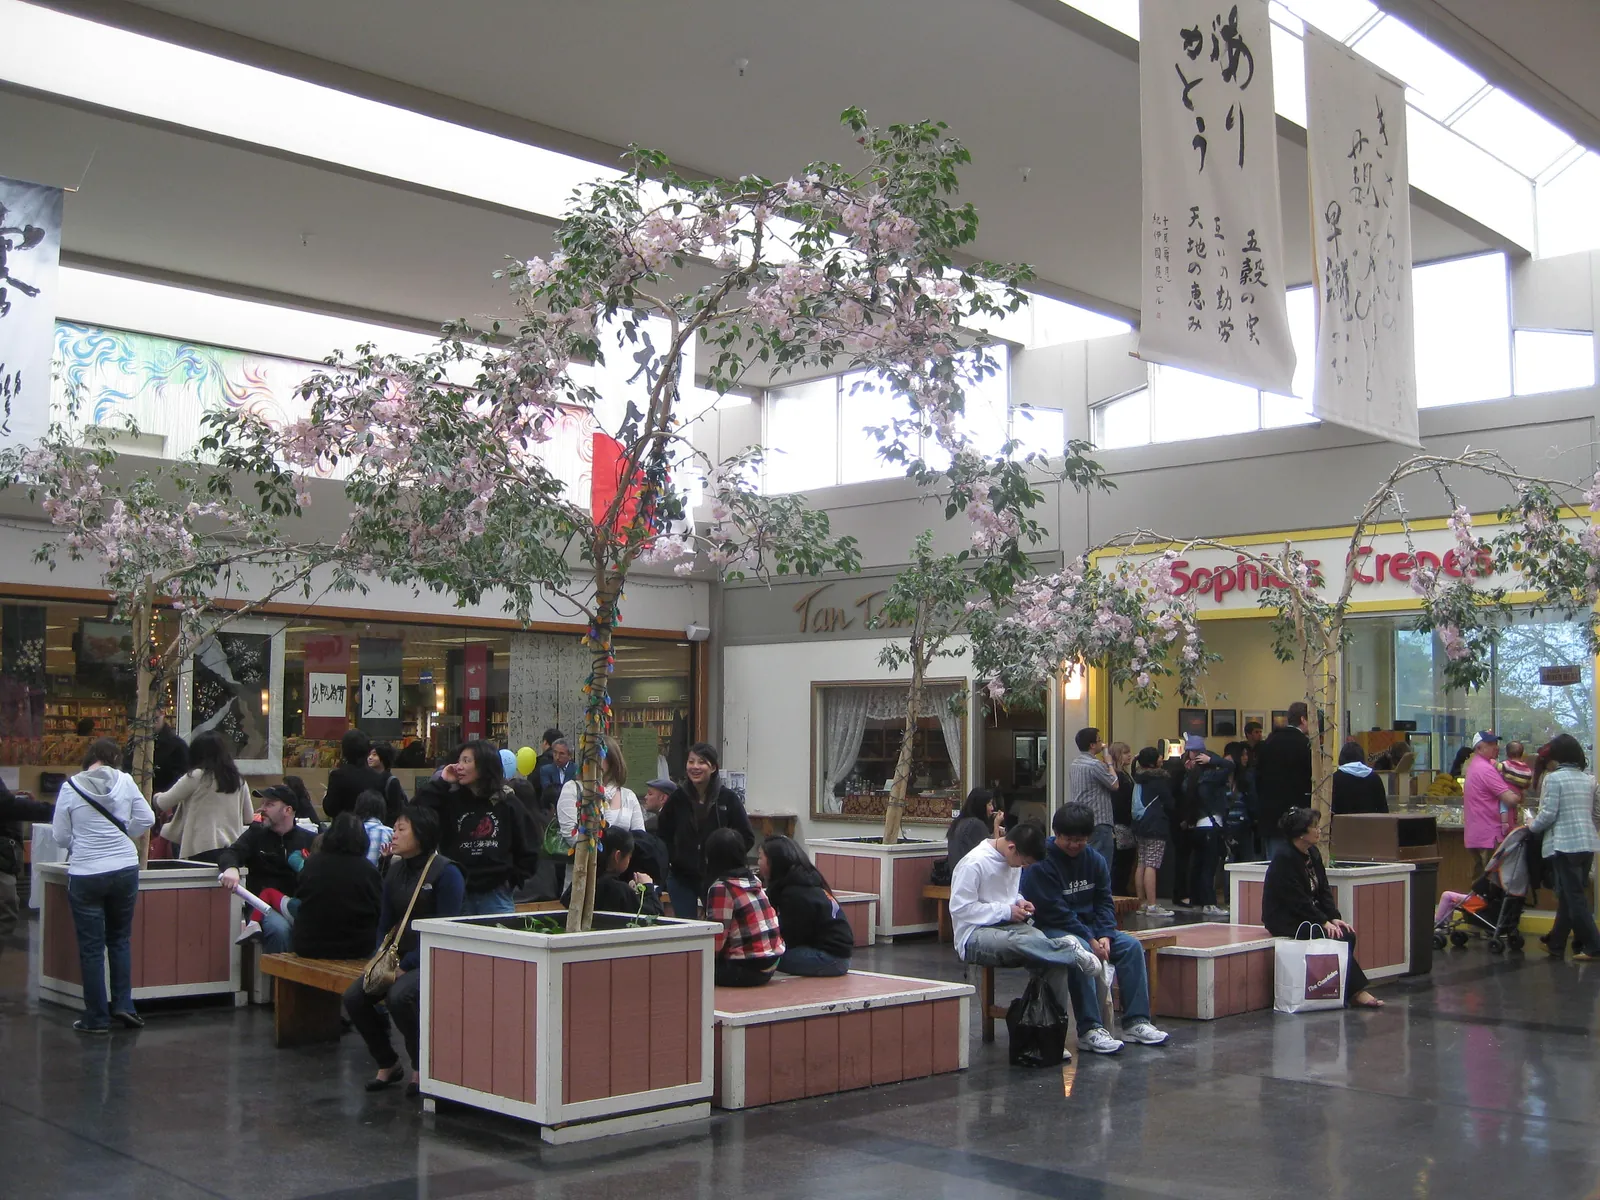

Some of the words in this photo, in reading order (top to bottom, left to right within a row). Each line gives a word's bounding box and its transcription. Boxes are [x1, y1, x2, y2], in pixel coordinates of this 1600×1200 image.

[1186, 205, 1207, 332] 天地の恵み
[1213, 216, 1235, 344] 互いの勤労
[1239, 229, 1268, 345] 五穀の実
[792, 582, 856, 633] Tan
